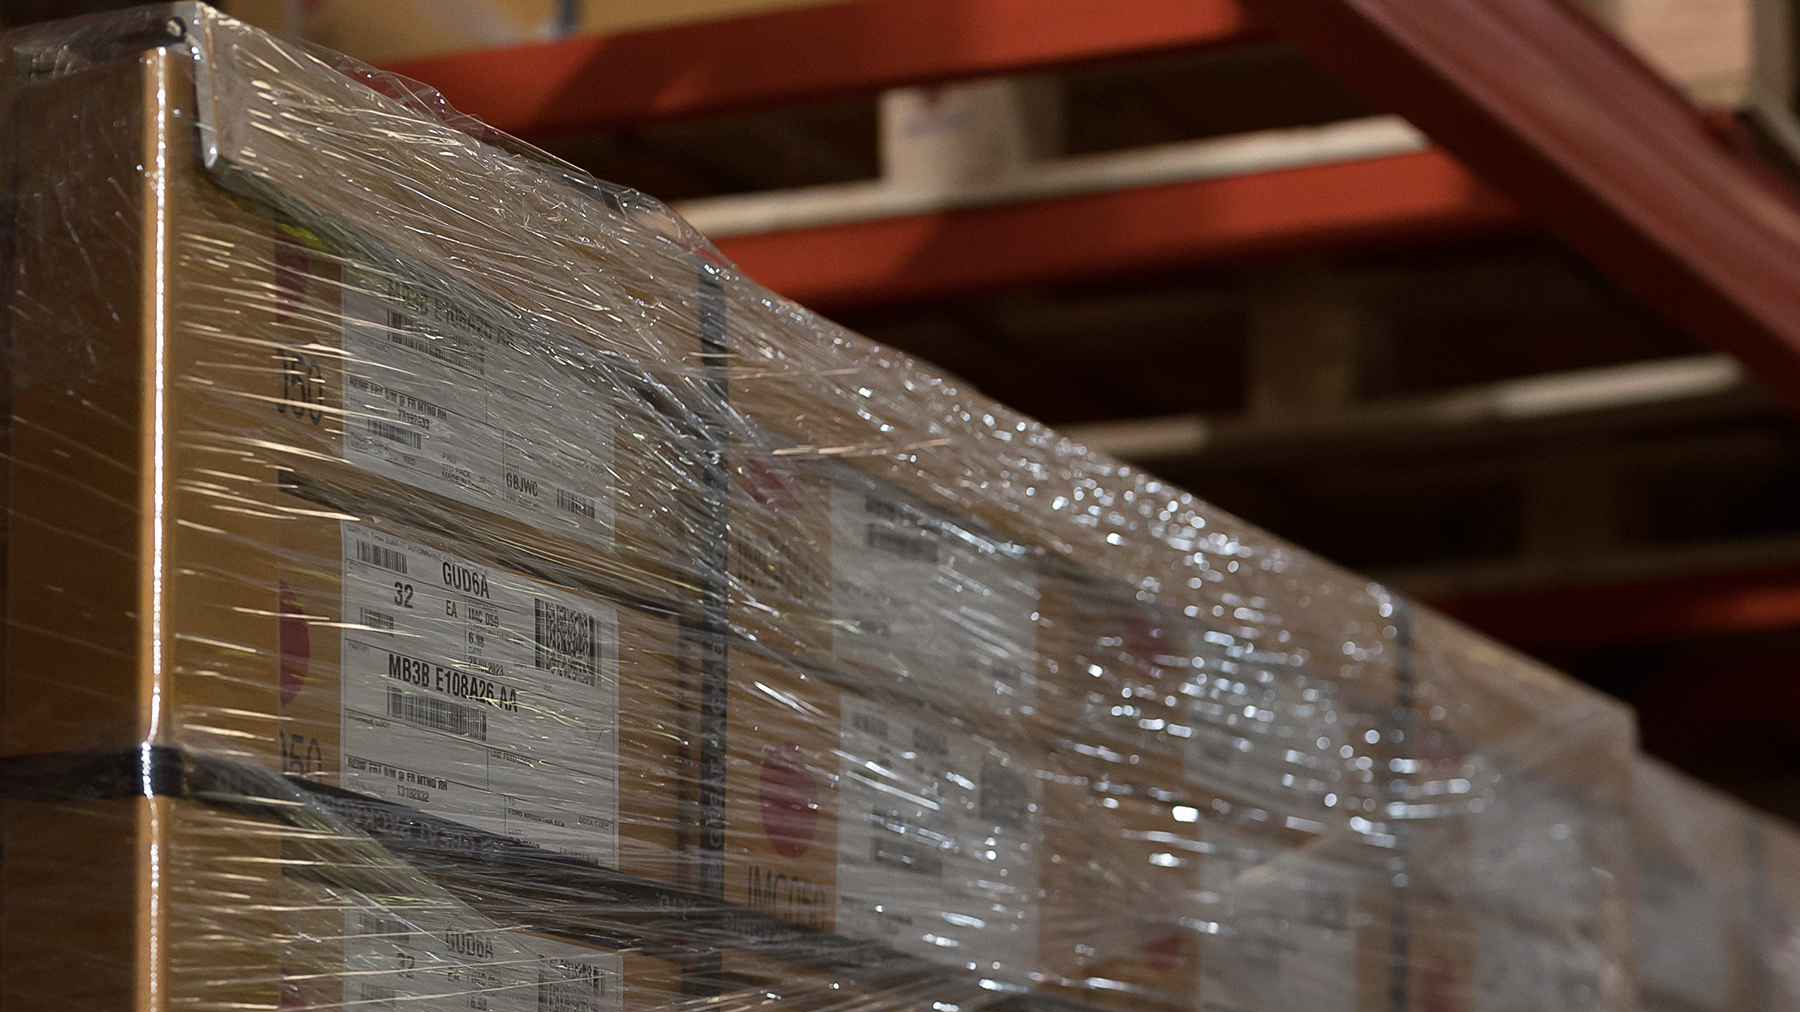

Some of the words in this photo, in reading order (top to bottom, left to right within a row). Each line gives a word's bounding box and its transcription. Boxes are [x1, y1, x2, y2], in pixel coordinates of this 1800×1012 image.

[506, 472, 538, 498] GBJWC
[442, 561, 490, 600] GUD6A
[394, 582, 413, 609] 32
[446, 600, 457, 619] EA
[468, 607, 483, 623] IMC
[388, 654, 430, 688] MB3B
[436, 667, 495, 708] E108A26
[499, 686, 519, 713] AA
[470, 996, 487, 1011] 6.98
